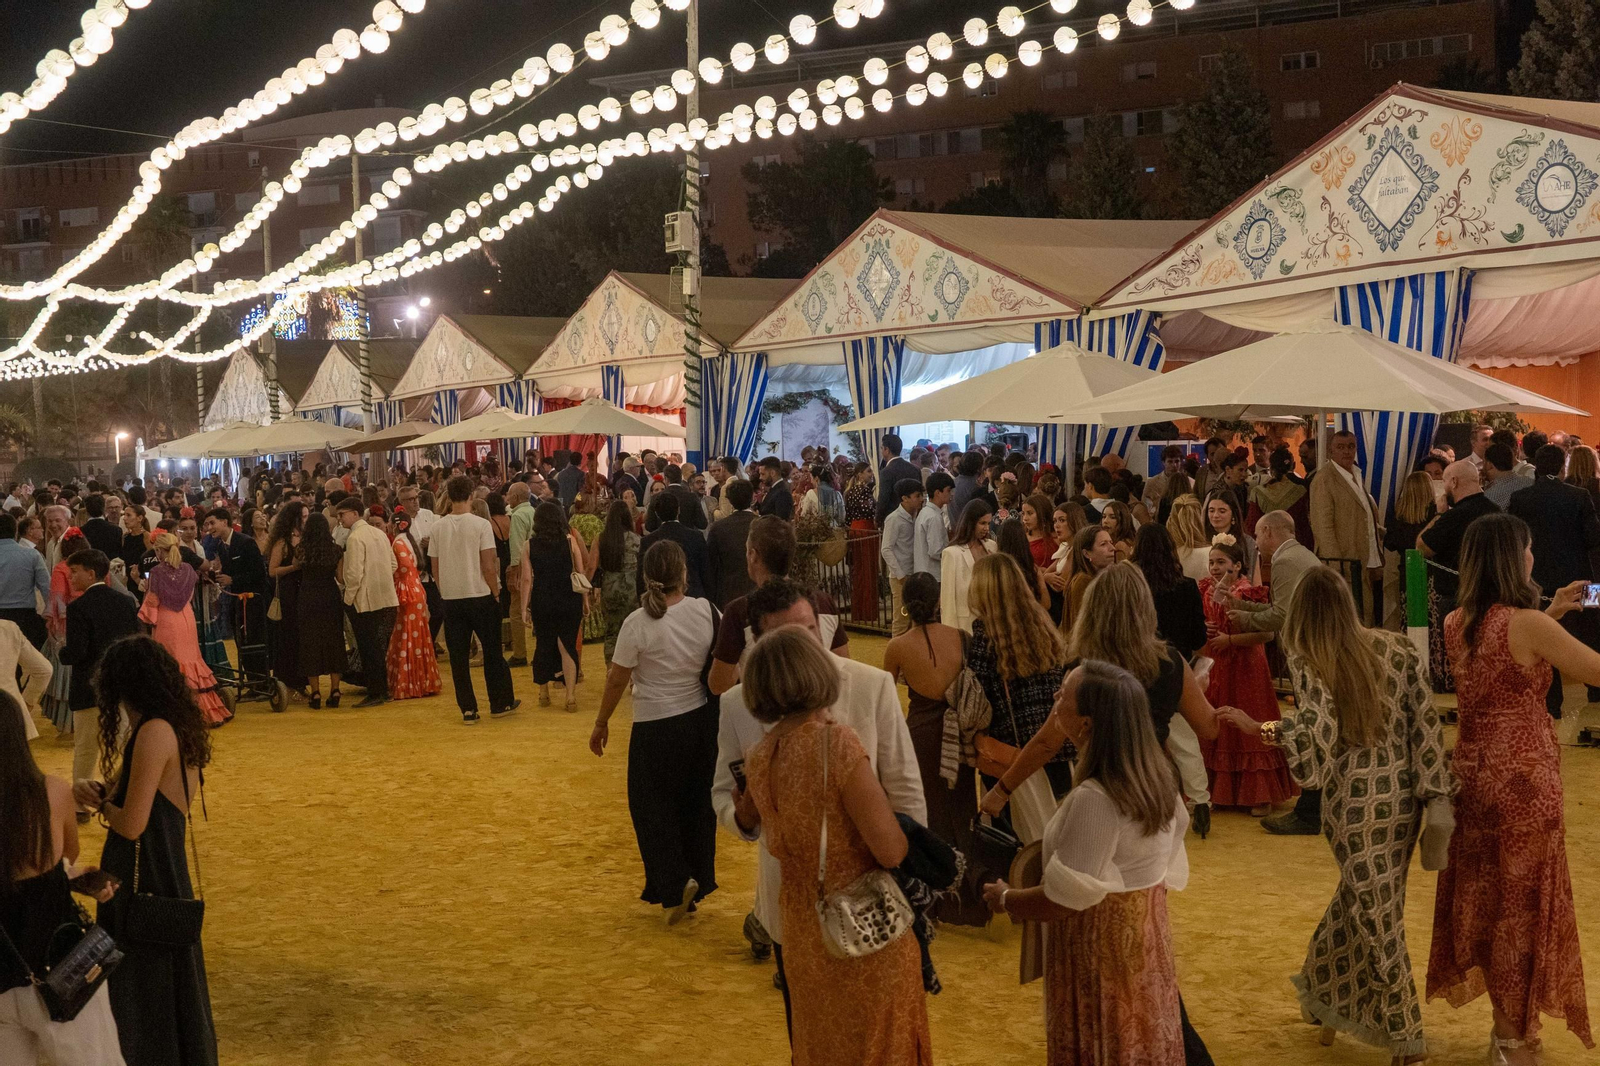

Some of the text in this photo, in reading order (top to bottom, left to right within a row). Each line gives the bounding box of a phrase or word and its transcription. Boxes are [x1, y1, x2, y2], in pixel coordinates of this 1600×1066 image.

[1379, 175, 1406, 186] Los que
[143, 556, 158, 565] STA
